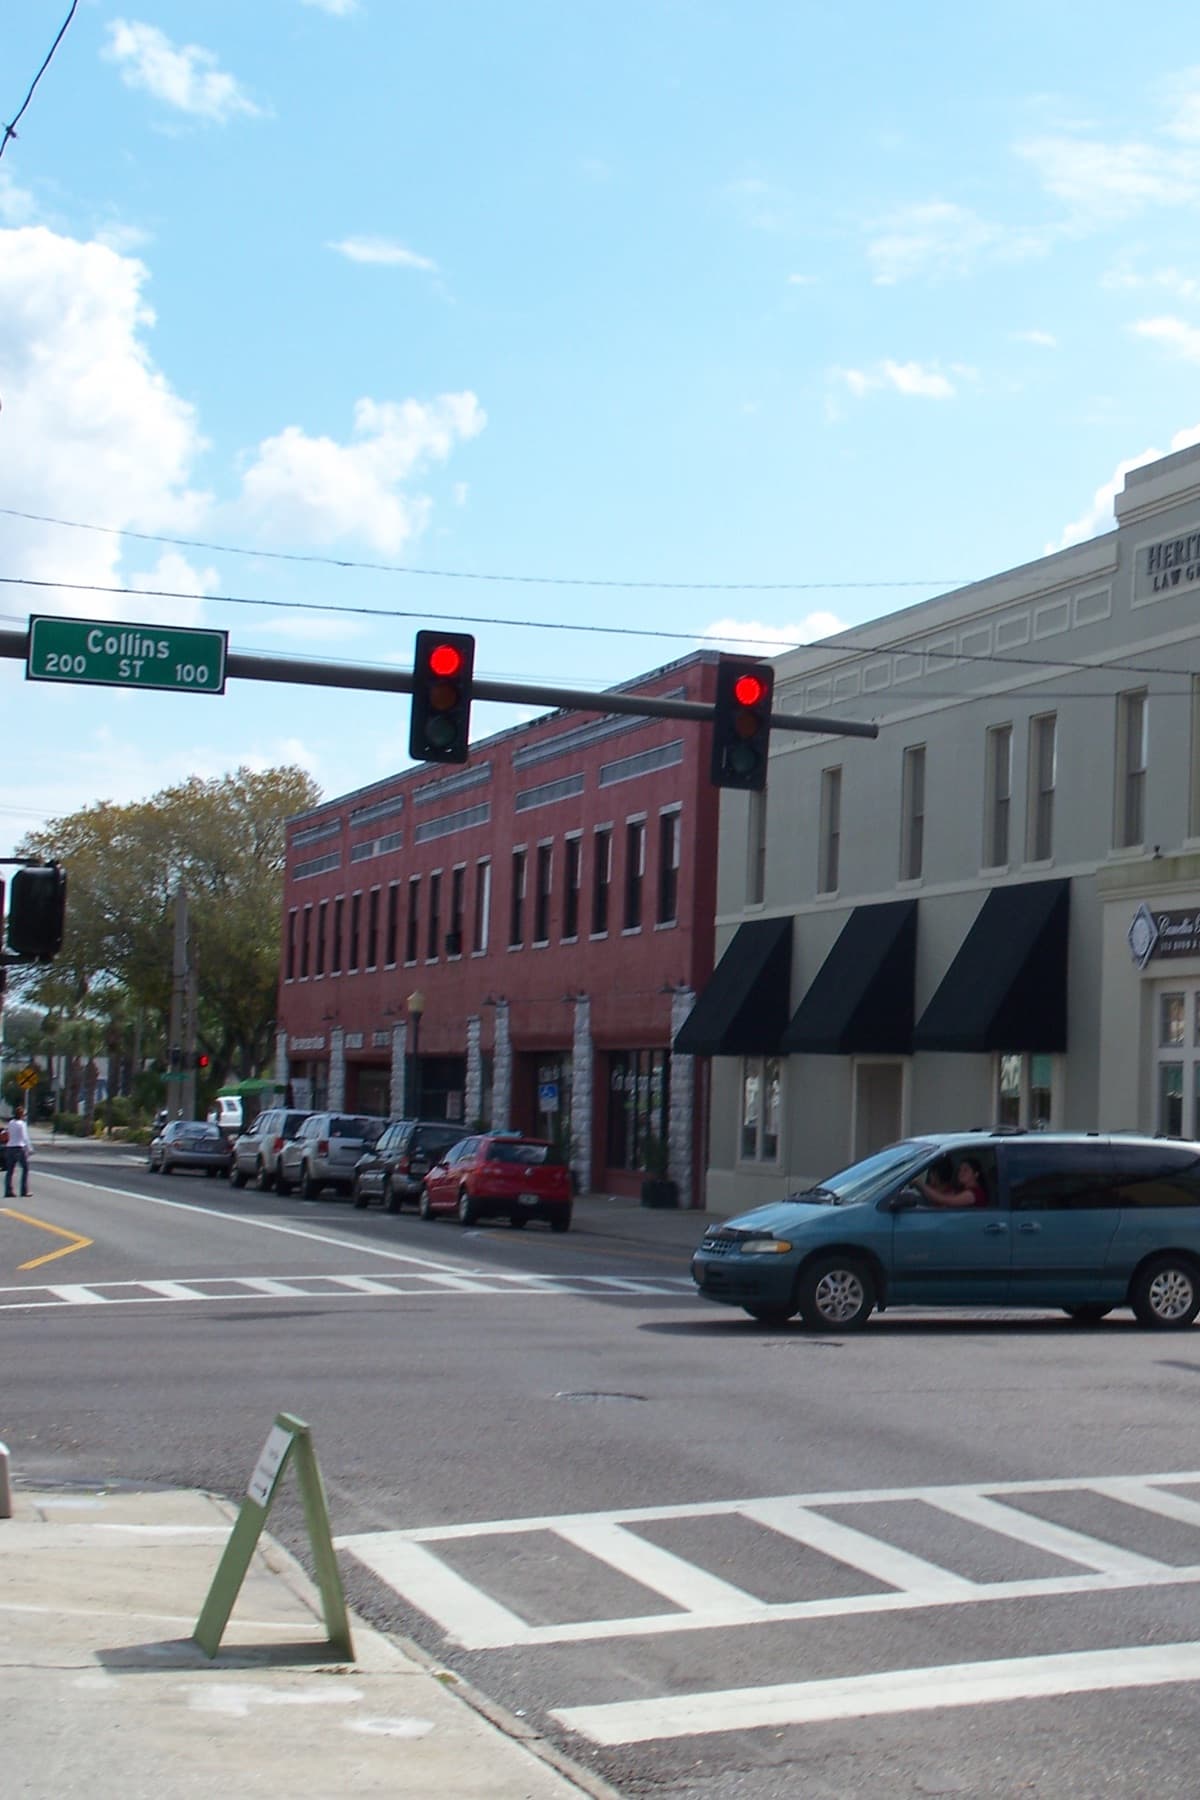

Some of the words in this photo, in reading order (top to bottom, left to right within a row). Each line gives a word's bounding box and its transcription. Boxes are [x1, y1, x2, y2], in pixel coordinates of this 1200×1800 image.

[1152, 567, 1182, 593] LAW
[86, 629, 171, 659] Collins
[45, 653, 87, 675] 200
[118, 659, 144, 679] ST
[175, 663, 209, 684] 100
